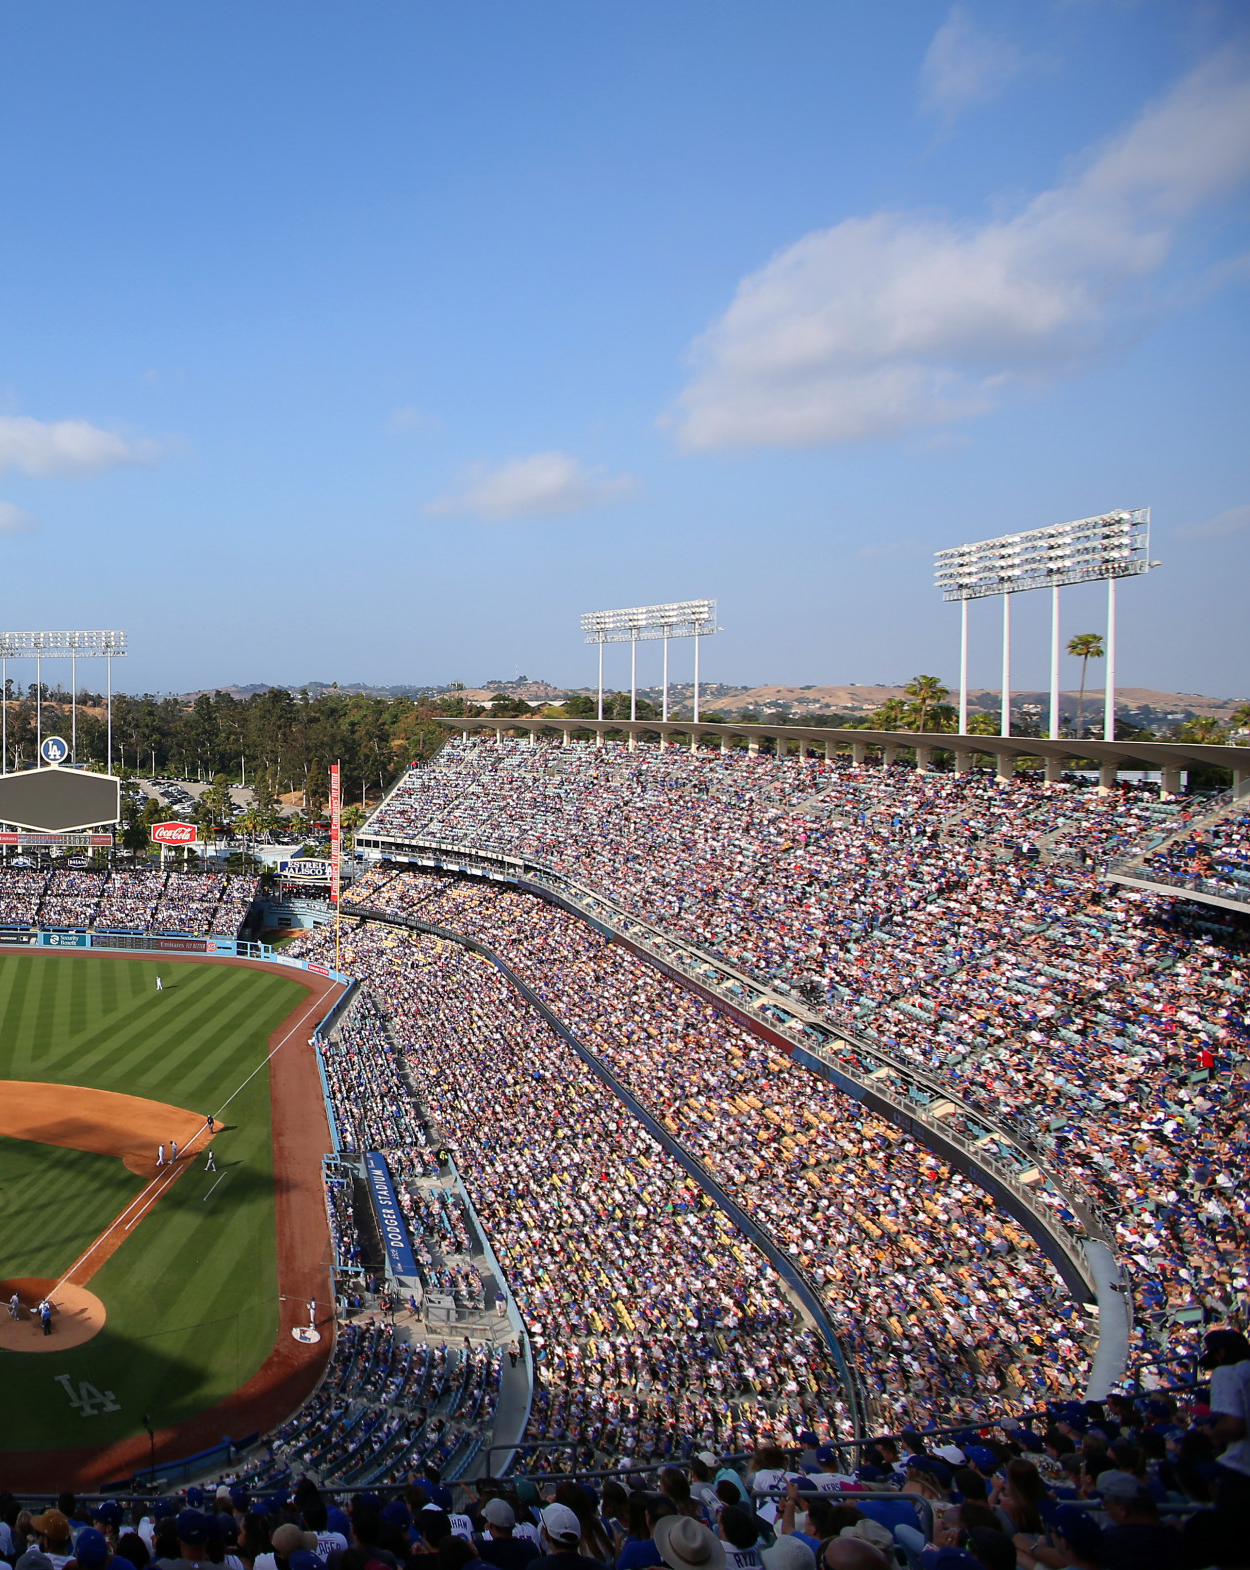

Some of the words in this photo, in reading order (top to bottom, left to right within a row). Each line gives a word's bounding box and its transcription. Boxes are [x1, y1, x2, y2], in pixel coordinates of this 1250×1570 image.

[48, 740, 61, 760] LA
[331, 799, 339, 830] Emirates
[283, 867, 323, 875] JALISCO
[331, 864, 339, 896] Emirates
[160, 941, 184, 949] Emirates
[371, 1168, 393, 1206] STADIUM
[382, 1208, 405, 1249] DODGER
[53, 1374, 123, 1418] LA
[733, 1551, 756, 1569] RYU
